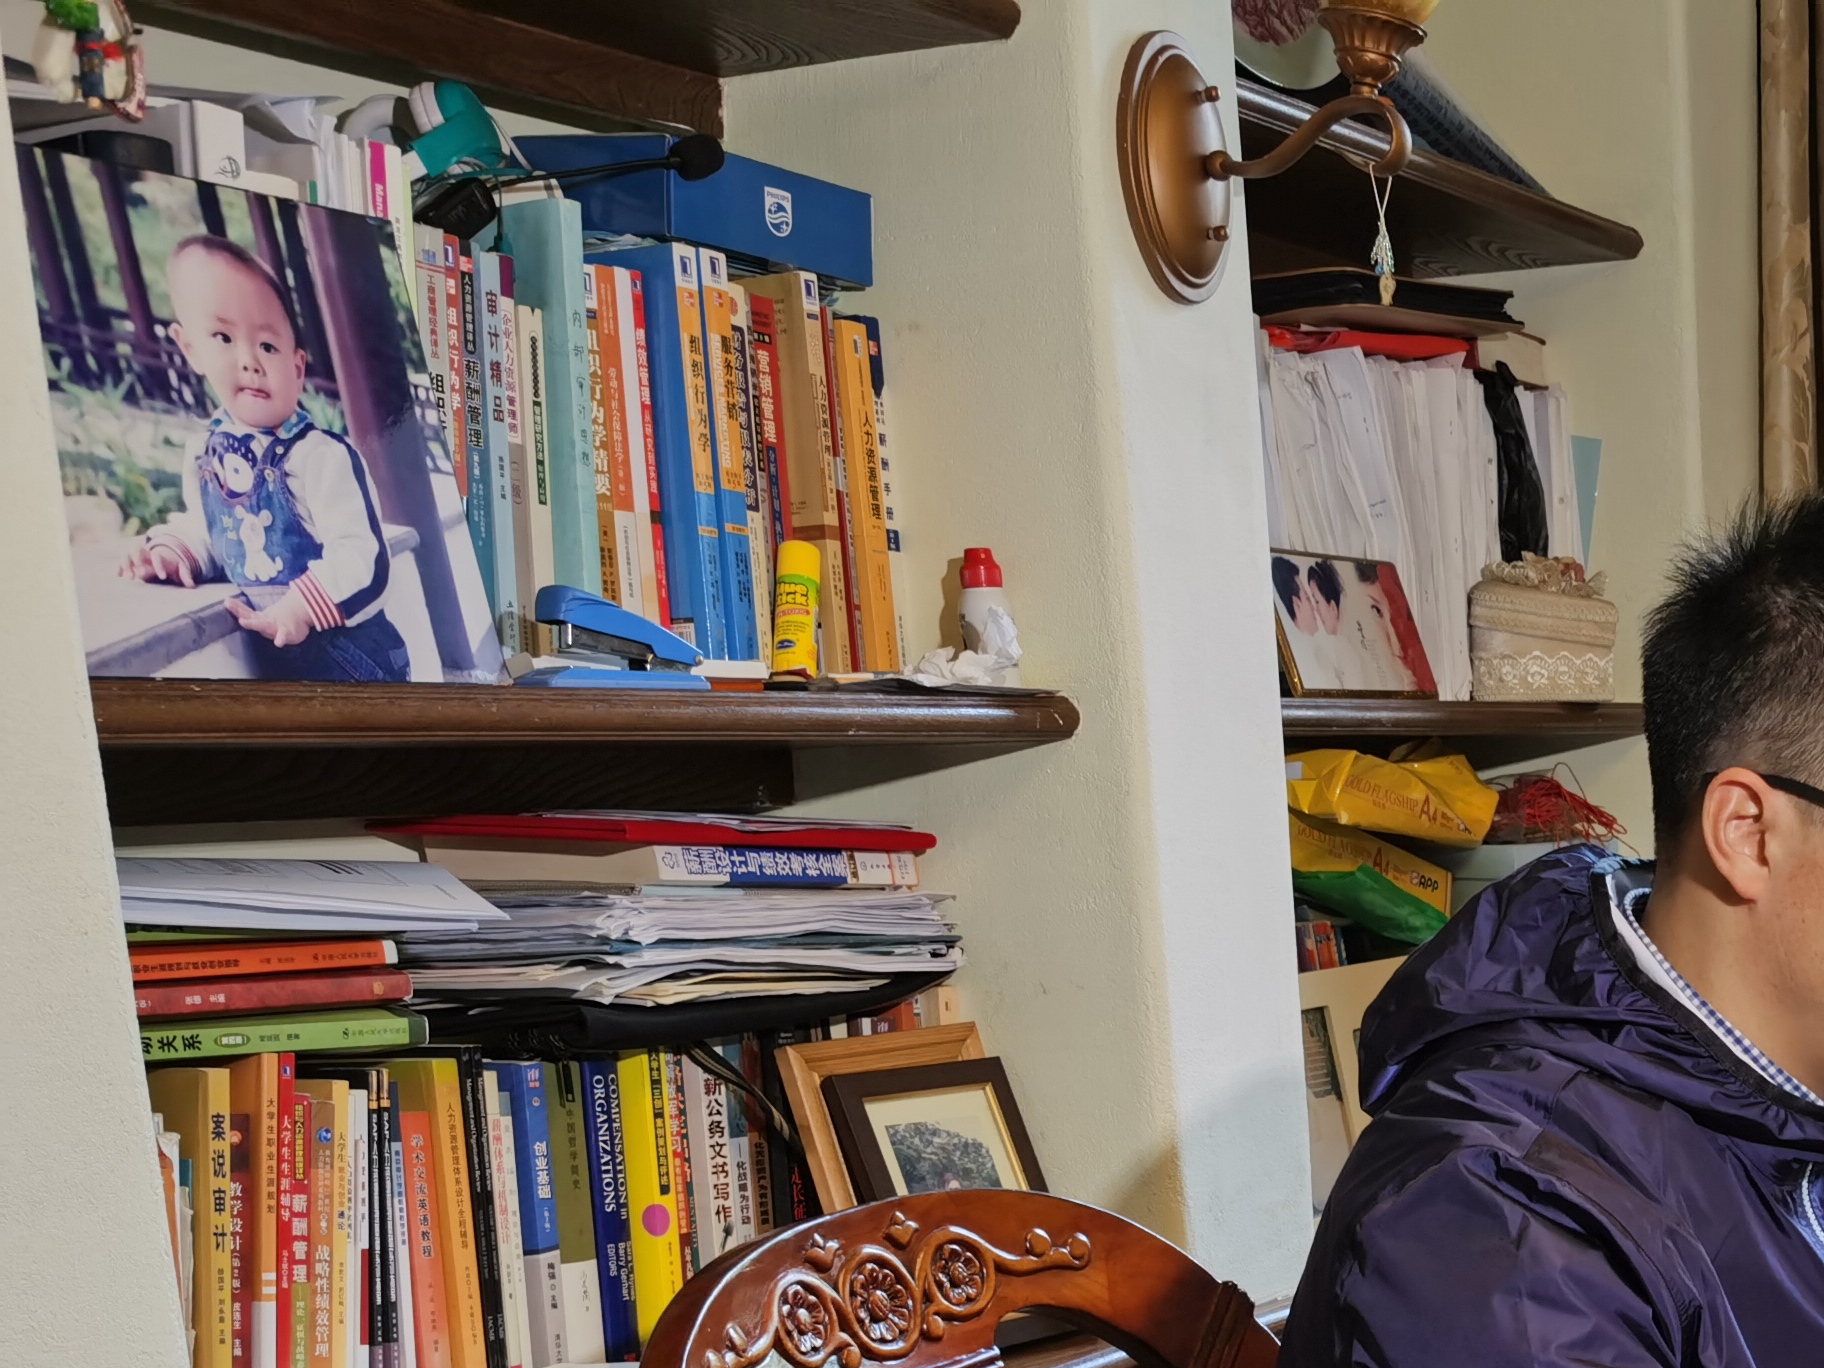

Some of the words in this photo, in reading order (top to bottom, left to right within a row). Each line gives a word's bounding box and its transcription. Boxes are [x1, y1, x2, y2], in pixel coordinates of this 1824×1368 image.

[485, 290, 505, 423] 审计精品
[502, 313, 518, 436] 企业人力资源管理师
[635, 328, 651, 405] 绩效管理
[689, 334, 711, 453] 组织行为学
[721, 335, 739, 423] 服务营销
[757, 349, 778, 443] 营销管理
[464, 358, 484, 448] 薪酬管理
[863, 411, 883, 521] 人力资源管理
[1345, 773, 1371, 795] GOLD
[1419, 795, 1438, 825] A4
[681, 847, 850, 878] 薪酬设计与绩效考核全案
[1373, 847, 1390, 877] A4
[1419, 875, 1440, 893] APP
[211, 1112, 228, 1254] 案说审计
[265, 1097, 277, 1214] 大学生职业生涯规划
[279, 1114, 292, 1223] 大学生生涯辅导
[533, 1140, 552, 1199] 创业基础
[592, 1074, 617, 1213] ORGANIZATIONS
[608, 1073, 628, 1204] COMPENSATION
[704, 1076, 733, 1224] 新公务文书写作
[291, 1193, 309, 1284] 薪酬管理
[410, 1134, 434, 1258] 学术交流英语教程
[314, 1244, 331, 1358] 战略性绩效管理
[607, 1243, 617, 1277] EDITORS
[618, 1242, 626, 1268] Barry
[621, 1267, 630, 1300] Gerhart
[232, 1338, 244, 1357] 主编
[554, 1333, 563, 1364] 清华大学
